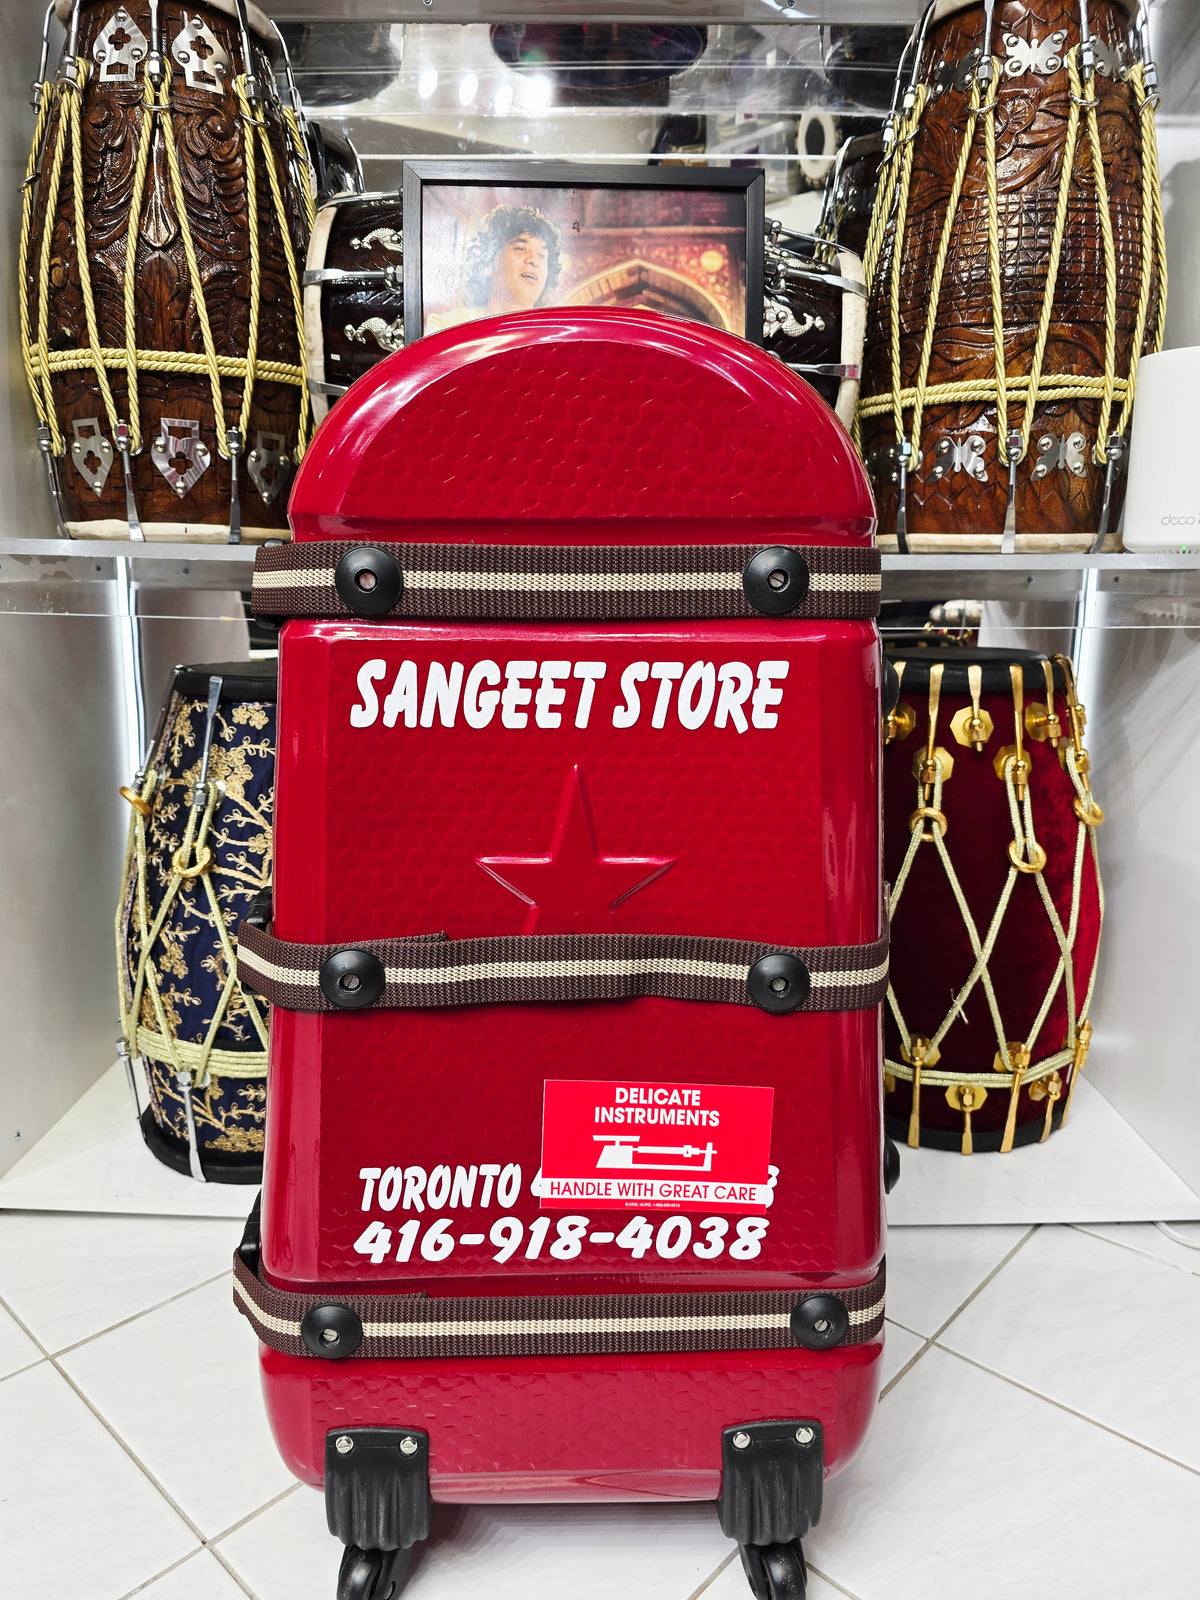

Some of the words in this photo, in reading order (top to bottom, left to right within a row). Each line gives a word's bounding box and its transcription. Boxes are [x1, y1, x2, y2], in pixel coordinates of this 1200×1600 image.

[1161, 514, 1195, 526] deco
[350, 659, 607, 729] SANGEET
[612, 661, 789, 734] STORE
[615, 1087, 701, 1107] DELICATE
[594, 1106, 720, 1127] INSTRUMENTS
[359, 1164, 521, 1213] TORONTO
[550, 1181, 612, 1196] HANDLE
[617, 1182, 654, 1197] WITH
[659, 1183, 710, 1199] GREAT
[714, 1185, 757, 1201] CARE
[353, 1215, 770, 1264] 416-918-4038
